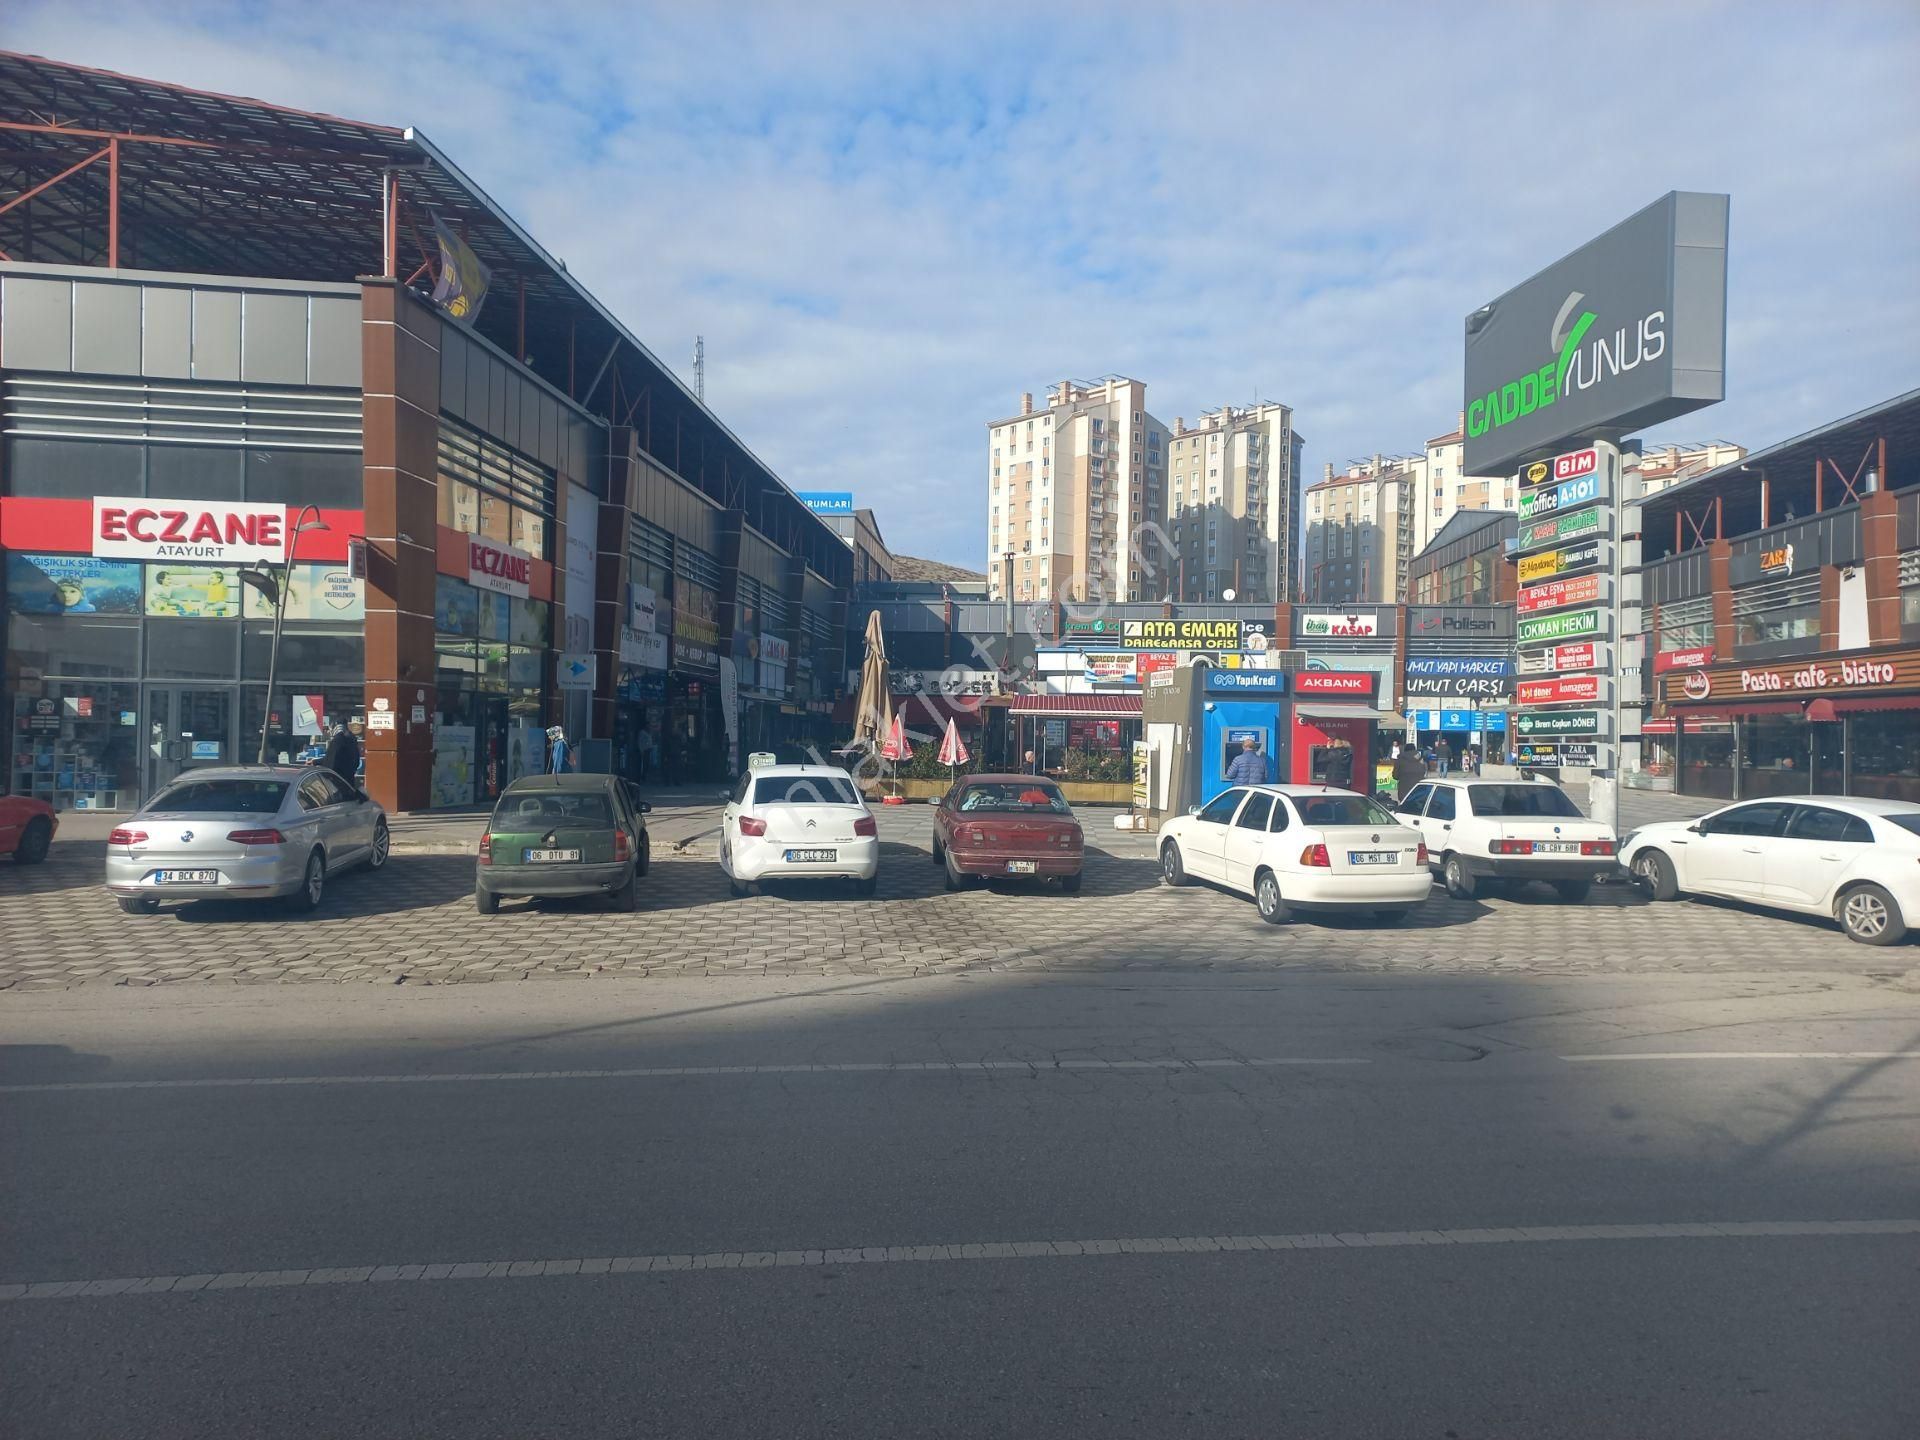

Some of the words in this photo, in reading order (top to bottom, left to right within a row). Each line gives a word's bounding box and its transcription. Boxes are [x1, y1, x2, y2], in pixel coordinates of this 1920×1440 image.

[100, 508, 281, 547] ECZANE
[157, 545, 225, 558] ATAYURT
[471, 542, 530, 584] ECZANE
[489, 579, 512, 592] ATAYURT
[1530, 586, 1548, 599] BEYAZ
[1143, 622, 1176, 637] ATA
[1181, 622, 1238, 638] EMLAK
[1332, 625, 1373, 636] KASAP
[1442, 617, 1496, 631] Polisan
[1519, 622, 1560, 639] LOKMAN
[1562, 612, 1595, 632] HEKİM
[1406, 661, 1434, 672] UMUT
[1436, 661, 1458, 673] YAPI
[1461, 661, 1505, 673] MARKET
[1741, 670, 1781, 692] Pasta
[1794, 663, 1827, 688] cafe
[1841, 660, 1895, 685] bistro
[1304, 678, 1362, 688] AKBANK
[1407, 678, 1452, 692] UMUT
[1456, 678, 1504, 695] ÇARŞI
[1572, 716, 1596, 728] DÖNER
[532, 850, 542, 860] 06
[791, 851, 801, 859] 06
[162, 871, 173, 881] 34
[178, 871, 194, 881] BCK
[198, 871, 215, 881] 870
